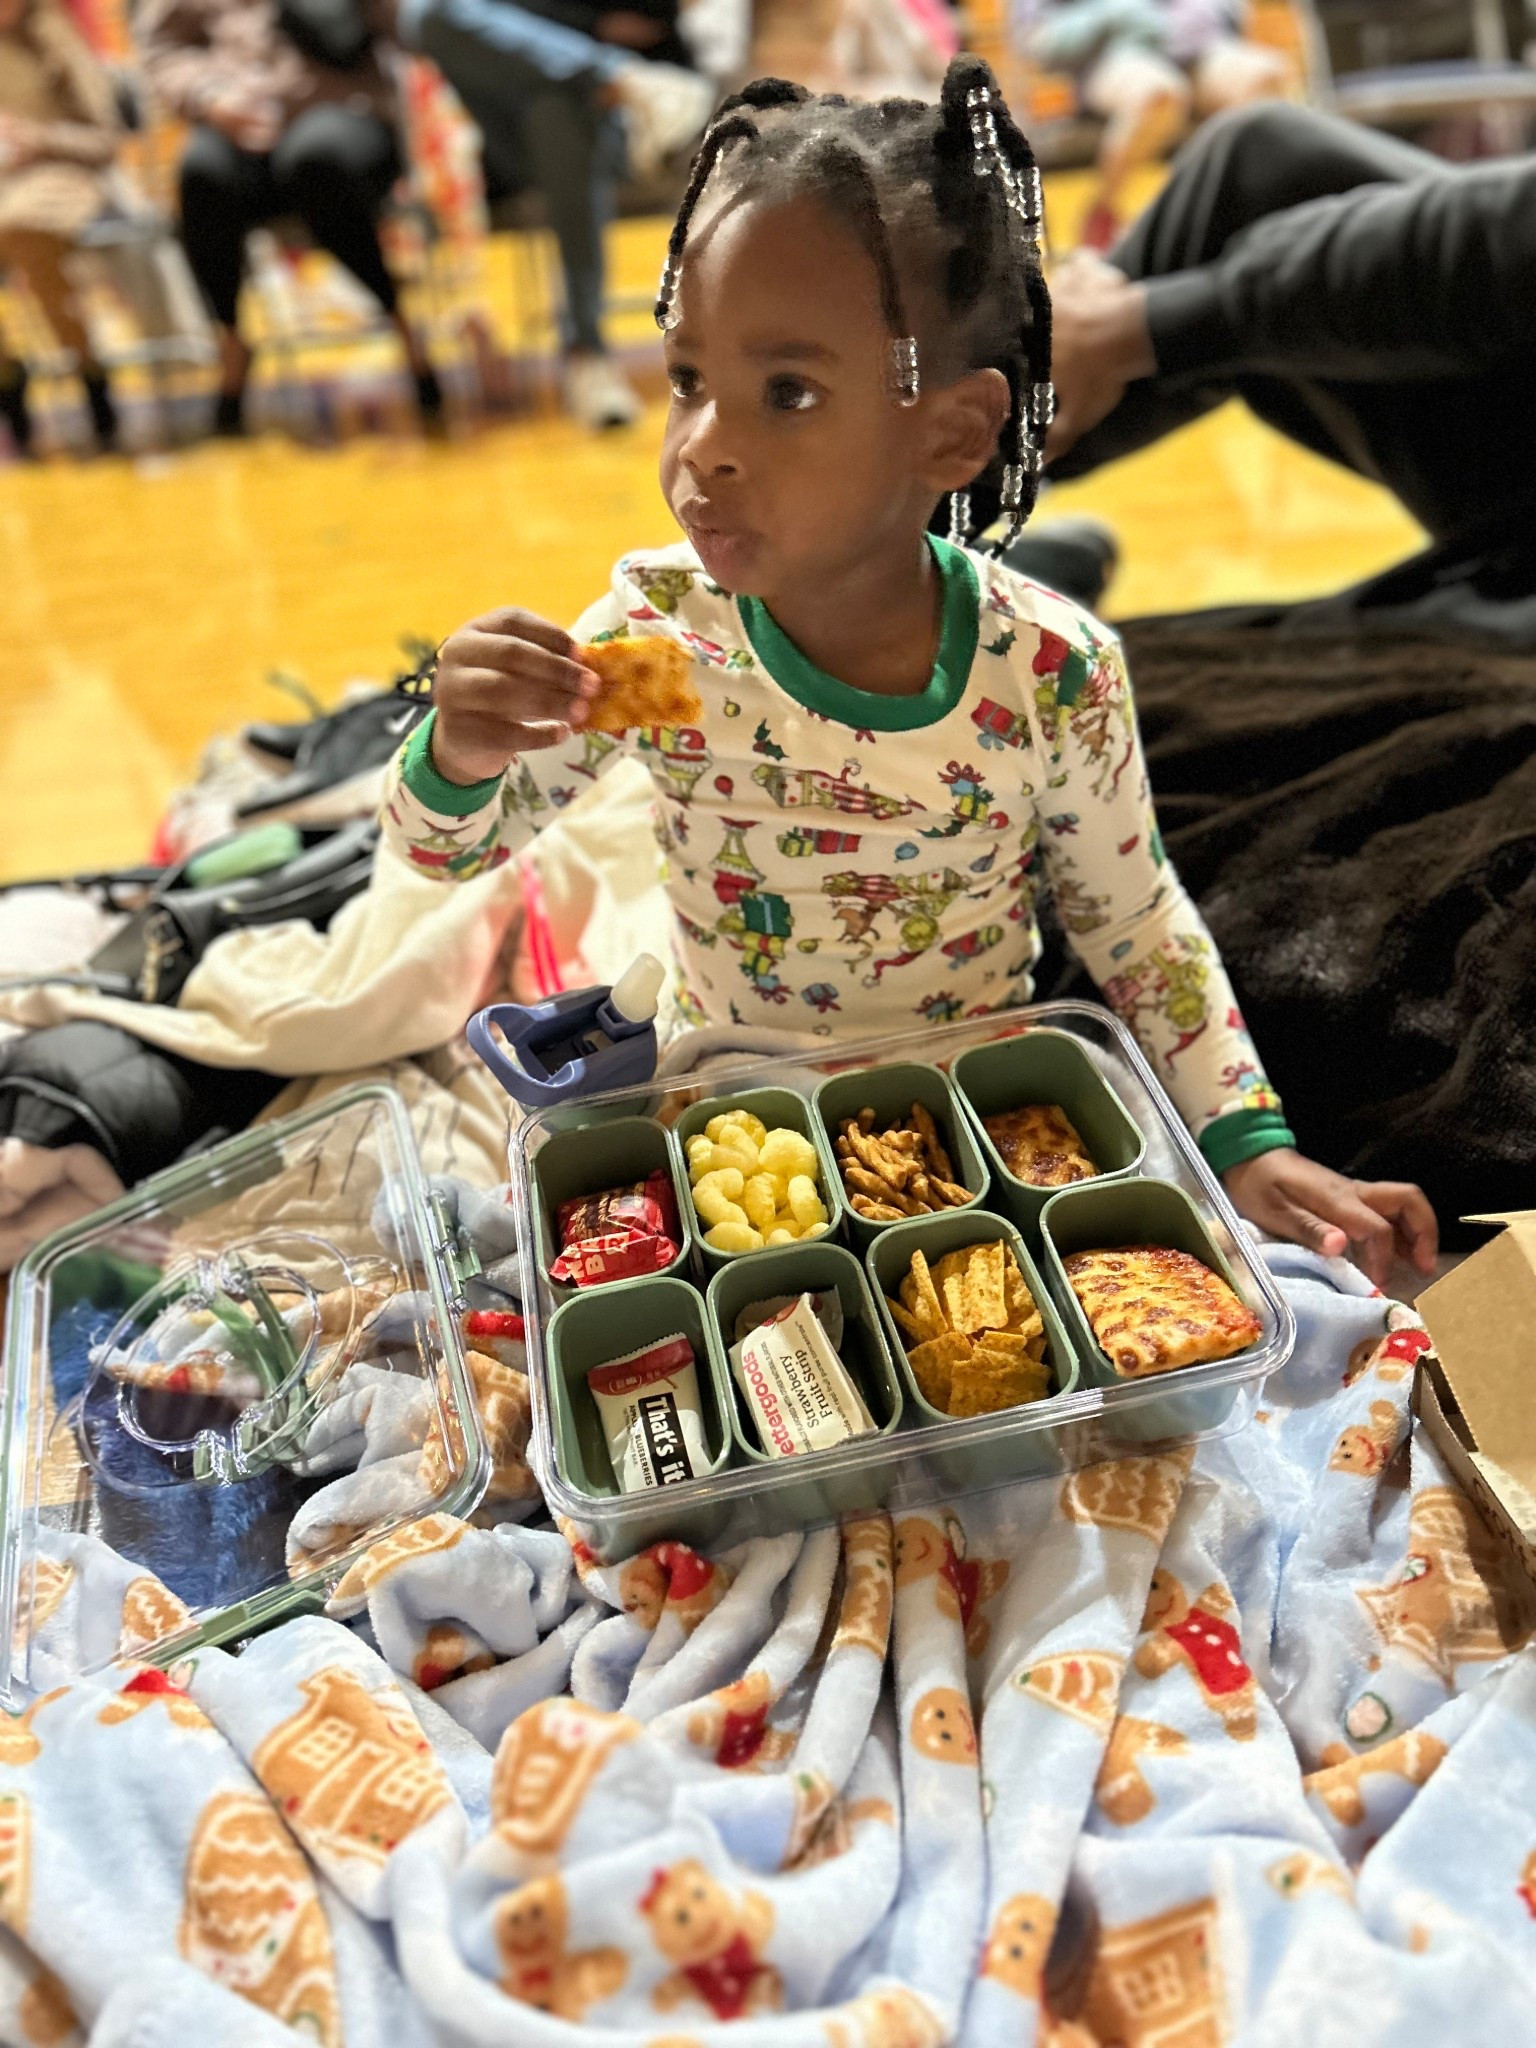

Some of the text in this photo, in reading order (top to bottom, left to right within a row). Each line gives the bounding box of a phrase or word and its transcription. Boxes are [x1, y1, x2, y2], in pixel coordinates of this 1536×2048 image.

[743, 1349, 800, 1456] ettergoods
[780, 1356, 819, 1428] Strawberry
[795, 1349, 833, 1418] Fruit Strip
[635, 1434, 653, 1486] BLUEBERRIES
[646, 1397, 679, 1457] That's
